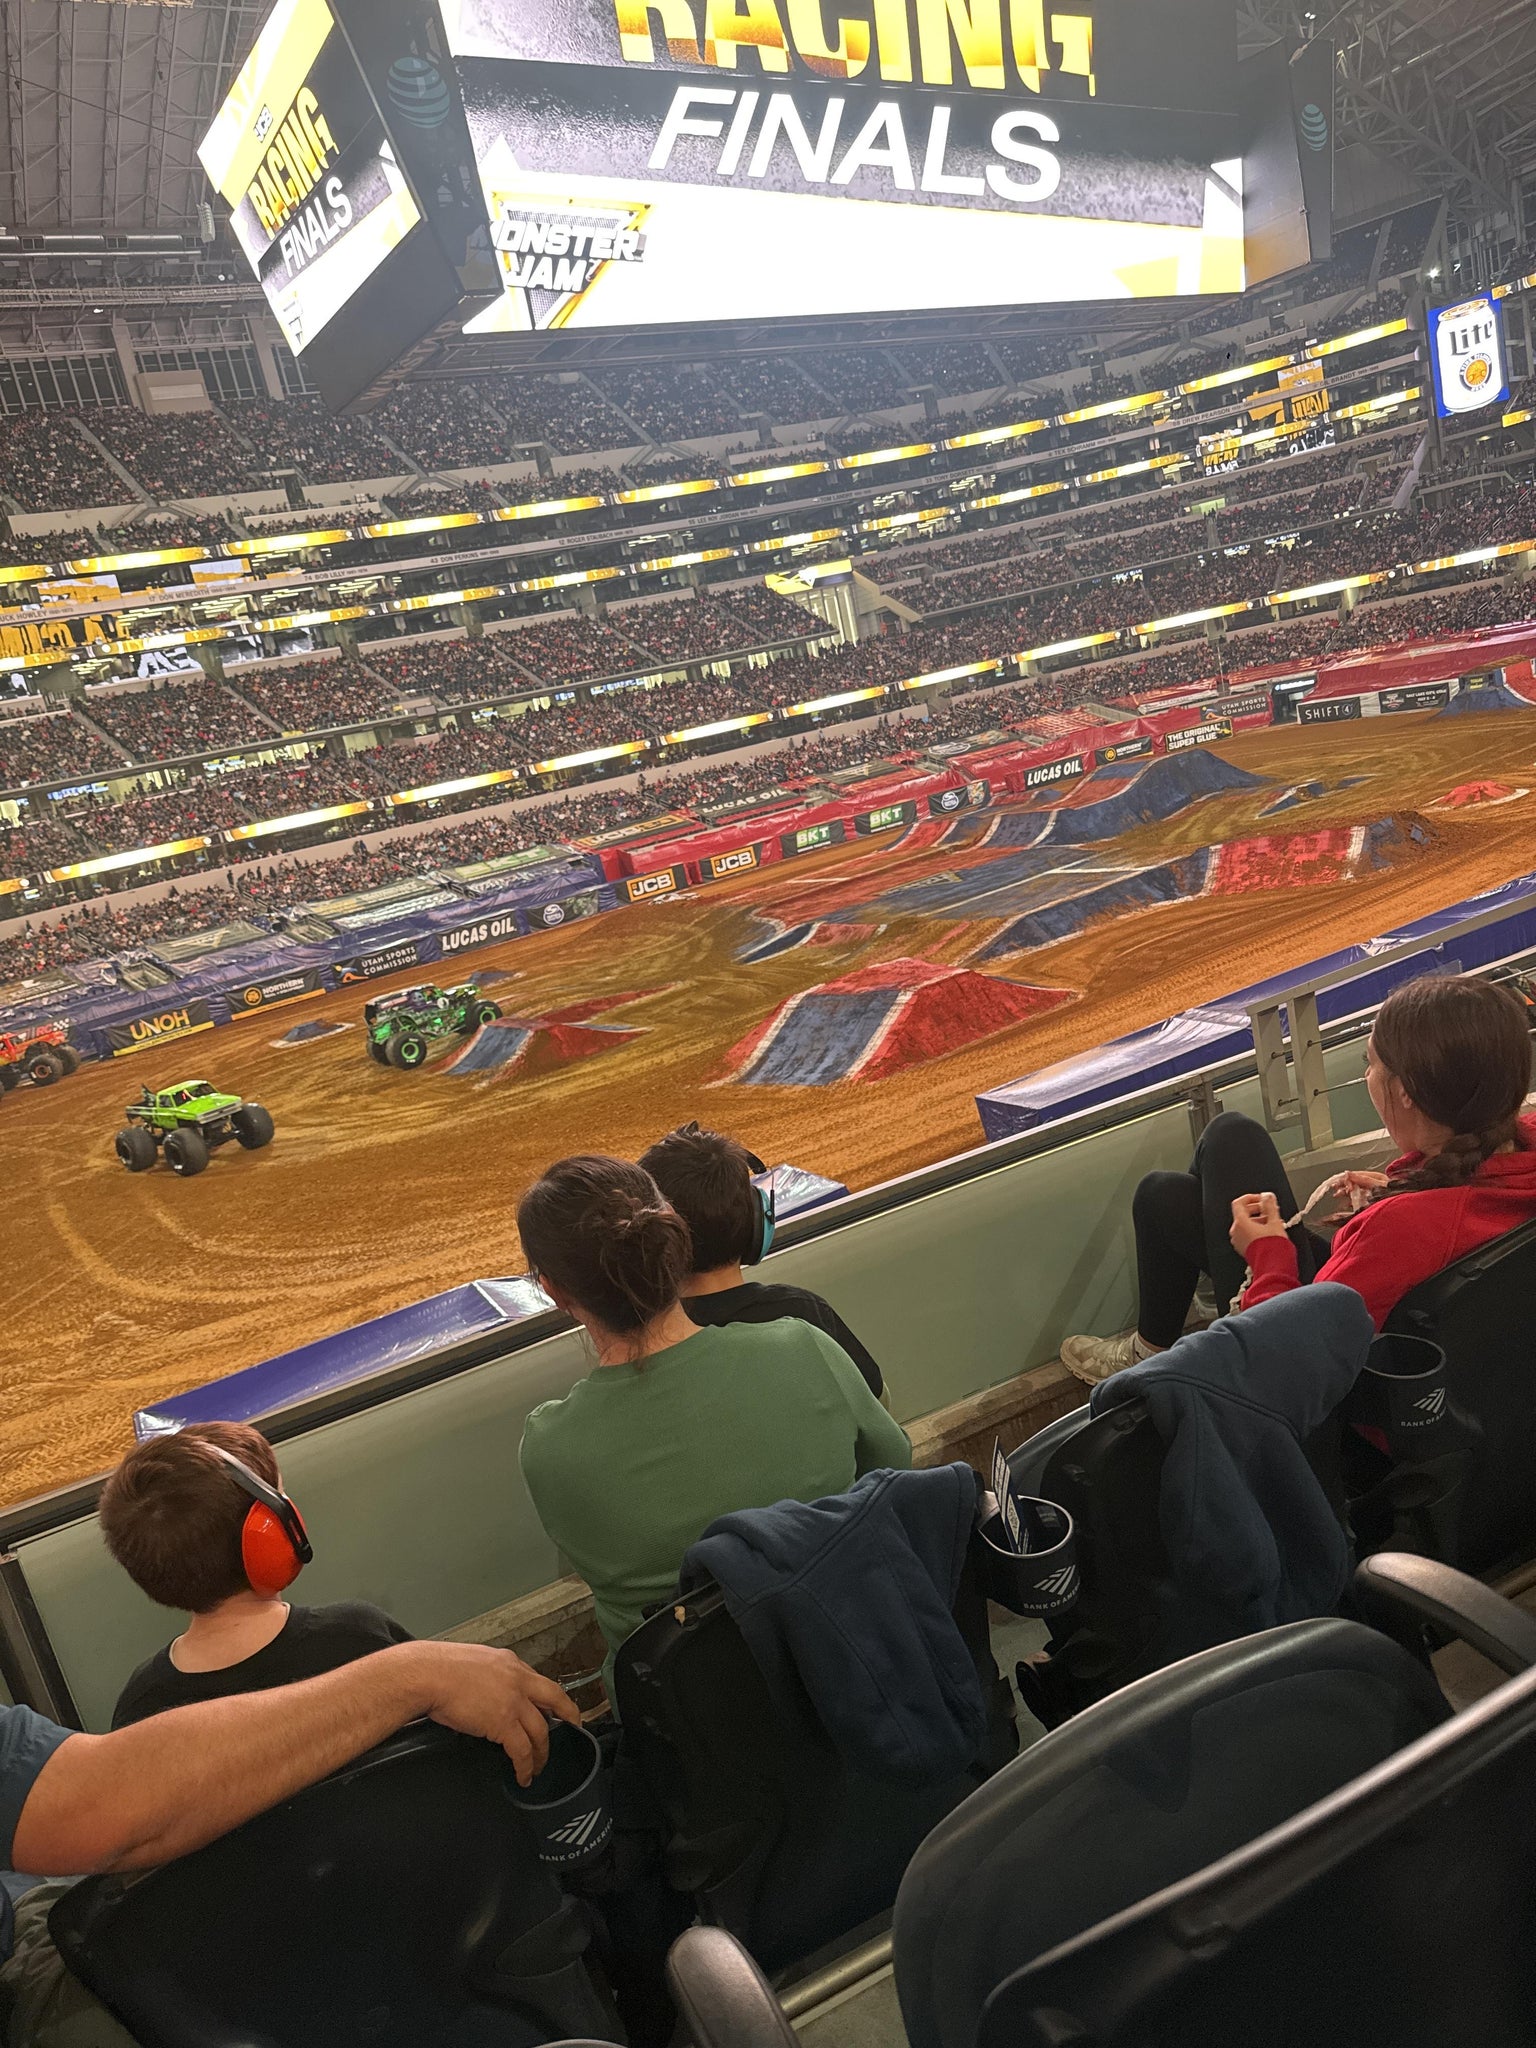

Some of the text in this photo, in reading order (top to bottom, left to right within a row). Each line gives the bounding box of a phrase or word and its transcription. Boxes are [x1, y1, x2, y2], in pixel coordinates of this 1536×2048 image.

[647, 86, 1061, 202] FINALS
[247, 86, 340, 241] RACING
[279, 176, 353, 278] FINALS
[504, 252, 588, 292] JAM
[1448, 320, 1493, 356] Lite
[1201, 408, 1231, 420] PEARSON
[566, 536, 586, 544] ROGER
[440, 555, 454, 563] DON
[454, 552, 479, 561] PERKINS
[329, 570, 345, 578] LILLY
[159, 592, 174, 601] DON
[175, 588, 210, 599] MEREDITH
[17, 609, 47, 620] HOWLEY
[1221, 696, 1266, 710] UTAH SPORTS
[1222, 702, 1267, 715] COMMISSION
[1305, 705, 1340, 720] SHIFT
[1167, 723, 1221, 742] THE ORIGINAL
[1168, 731, 1218, 750] SUPER GLUE
[1027, 759, 1082, 786] LUCAS OIL
[702, 788, 787, 813] LUCAS OIL
[871, 807, 902, 827] BKT
[796, 826, 829, 846] BKT
[716, 851, 753, 873] JCB
[632, 873, 673, 896] JCB
[442, 917, 515, 951] LUCAS OIL
[361, 945, 416, 968] UTAH SPORTS
[363, 954, 417, 976] COMMISSION
[262, 978, 304, 995] NORTHERN
[129, 1009, 190, 1040] UNOH
[1400, 1420, 1424, 1428] BANK
[1023, 1602, 1048, 1610] BANK
[1050, 1599, 1061, 1608] OF
[538, 1853, 566, 1862] BANK
[568, 1850, 581, 1860] OF
